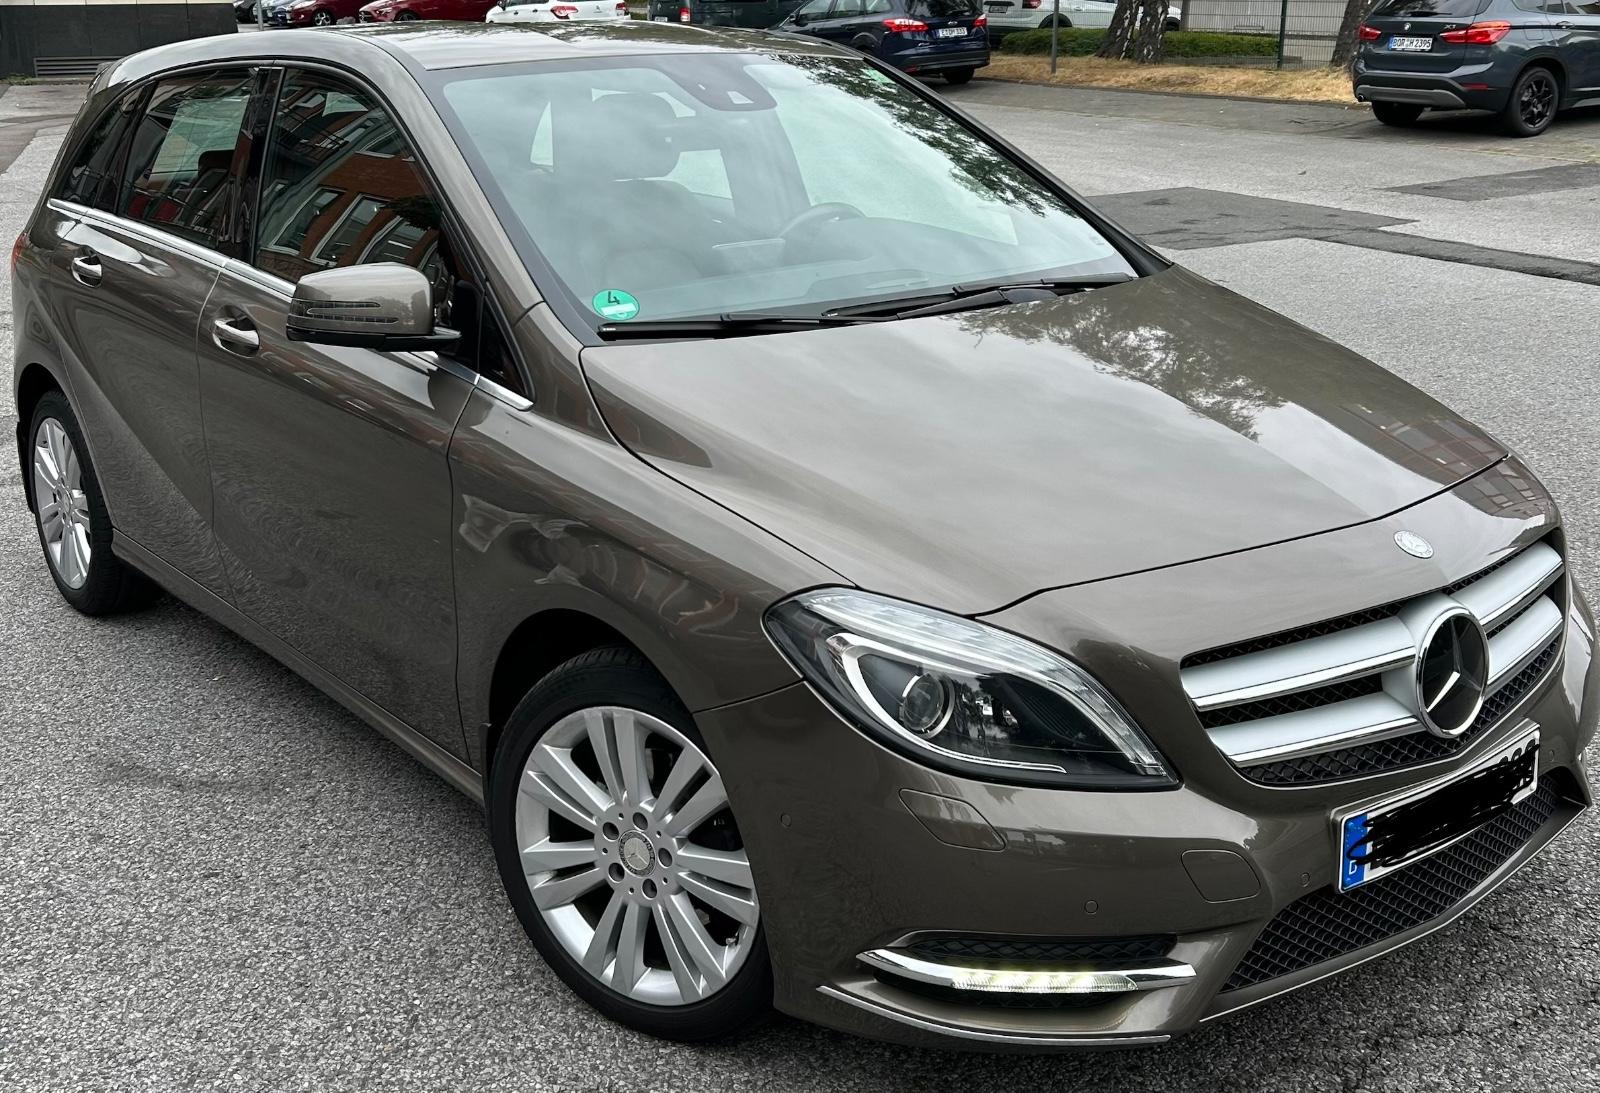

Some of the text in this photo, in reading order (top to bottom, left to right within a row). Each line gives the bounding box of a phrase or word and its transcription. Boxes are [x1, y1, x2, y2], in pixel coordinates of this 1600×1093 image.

[1392, 38, 1405, 47] BOR
[1414, 39, 1431, 48] 2395
[607, 291, 620, 304] 4
[1348, 859, 1358, 875] D
